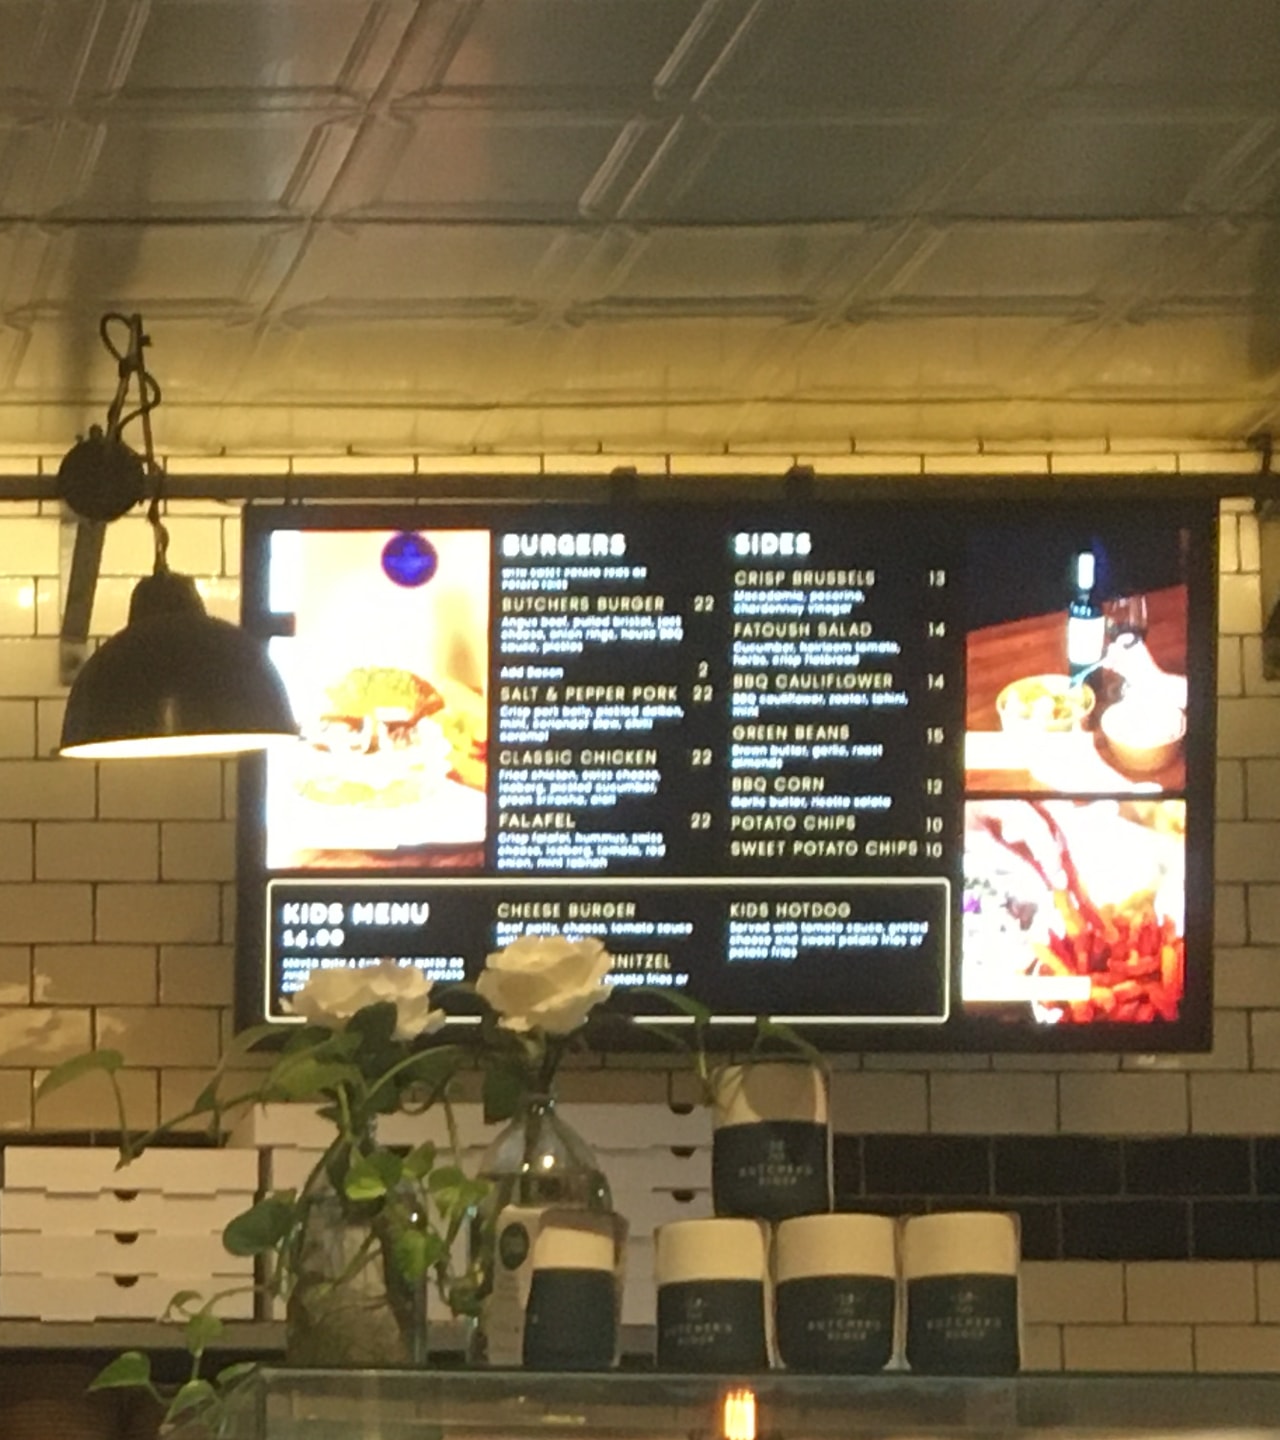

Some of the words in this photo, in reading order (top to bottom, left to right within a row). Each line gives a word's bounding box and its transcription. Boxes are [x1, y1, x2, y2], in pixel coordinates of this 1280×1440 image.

[501, 534, 626, 557] BURGERS
[733, 533, 811, 556] SIDES
[735, 571, 785, 586] CRISP
[793, 571, 874, 585] BRUSSELS
[502, 597, 589, 611] BUTCHERS
[598, 596, 664, 611] BURGER
[695, 596, 714, 611] 22
[734, 623, 809, 637] FATOUSH
[818, 622, 871, 637] SALAD
[734, 674, 768, 689] BBQ
[776, 674, 892, 688] CAULIFLOWER
[501, 687, 537, 701] SALT
[566, 686, 624, 701] PEPPER
[633, 686, 676, 701] PORK
[694, 685, 712, 701] 22
[733, 725, 787, 740] GREEN
[795, 725, 849, 740] BEANS
[499, 750, 571, 765] CLASSIC
[581, 750, 656, 764] CHICKEN
[692, 749, 712, 765] 22
[732, 777, 766, 792] BBQ
[774, 777, 824, 792] CORN
[499, 813, 575, 828] FALAFEL
[691, 813, 711, 828] 22
[732, 816, 796, 830] POTATO
[804, 815, 855, 830] CHIPS
[927, 817, 943, 833] 10
[731, 841, 785, 856] SWEET
[794, 841, 858, 856] POTATO
[866, 841, 917, 856] CHIPS
[926, 843, 942, 857] 10
[282, 903, 344, 925] KIDS
[350, 903, 429, 925] MENU
[498, 903, 559, 918] CHEESE
[569, 903, 635, 918] BURGER
[730, 903, 768, 918] KIDS
[776, 903, 850, 918] HOTDOG
[608, 954, 670, 969] NITZEL
